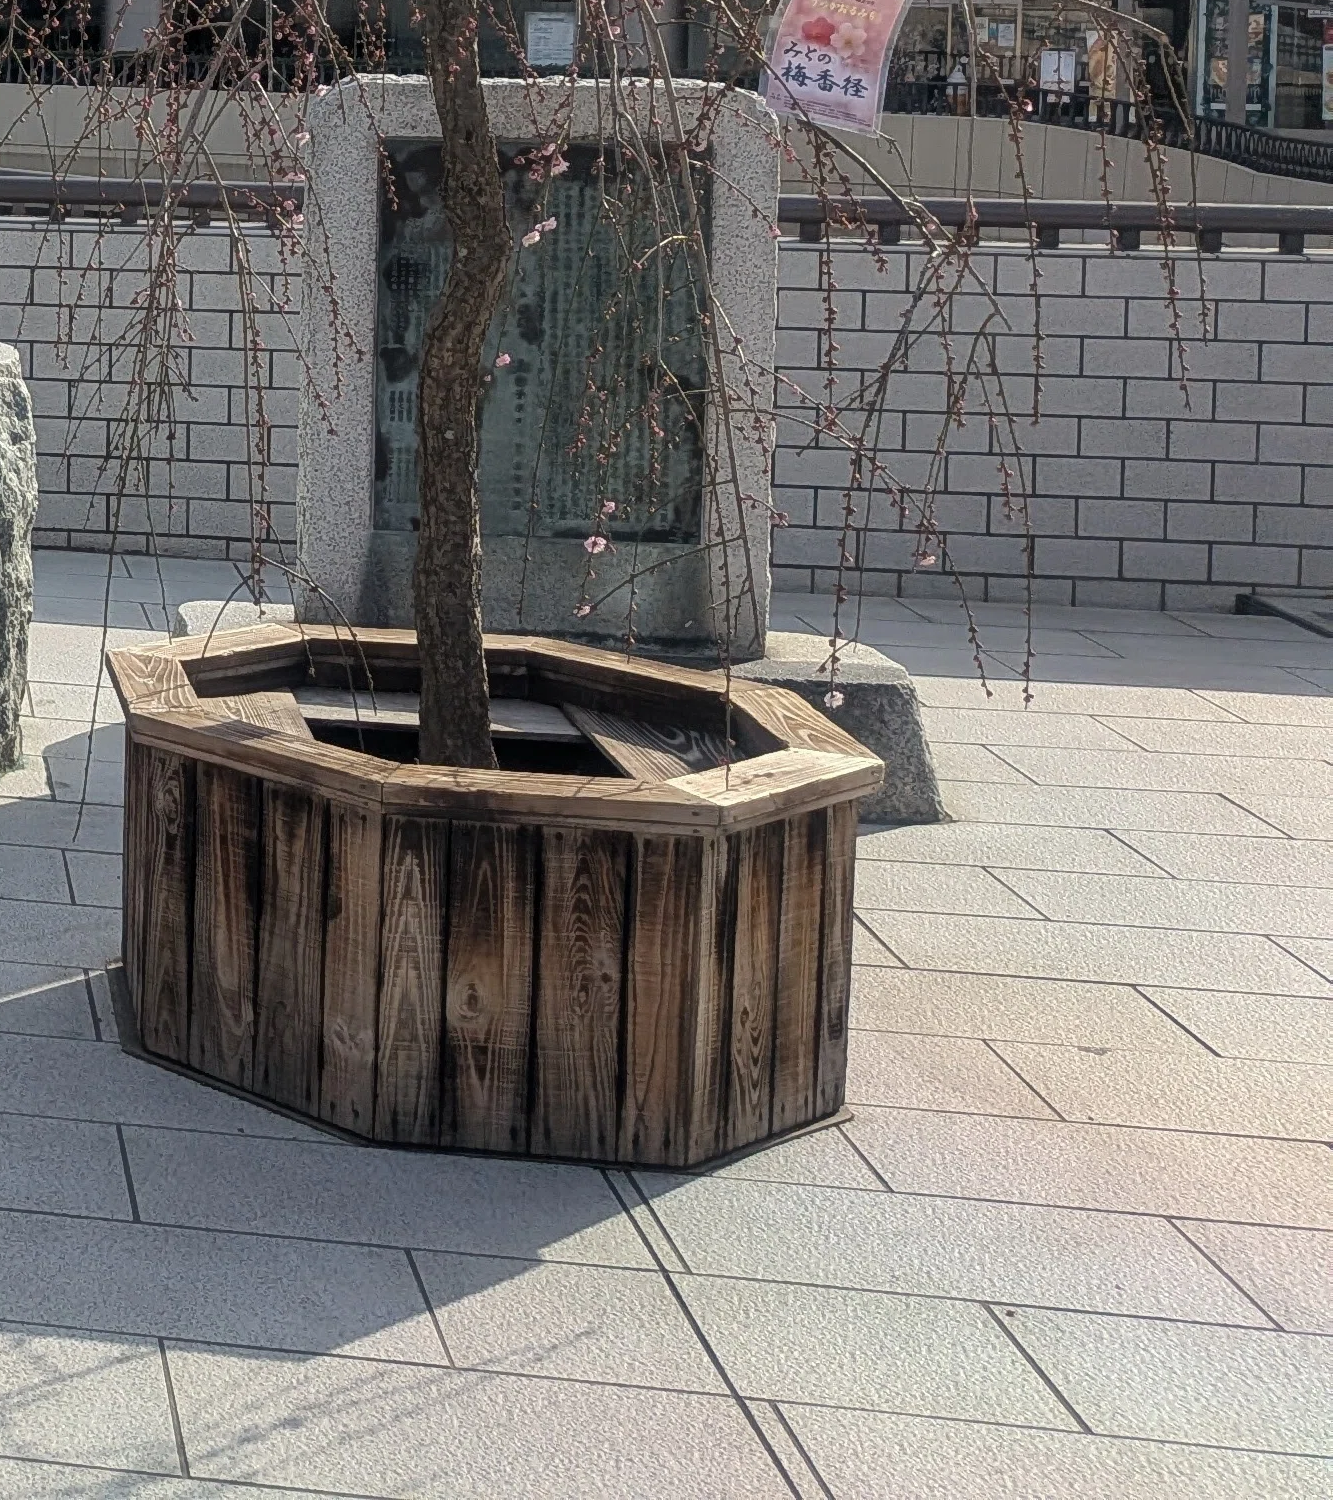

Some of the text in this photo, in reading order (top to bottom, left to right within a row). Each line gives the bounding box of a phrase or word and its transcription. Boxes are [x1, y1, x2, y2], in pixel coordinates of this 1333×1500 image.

[783, 41, 831, 65] みとの
[781, 61, 868, 99] 梅香径
